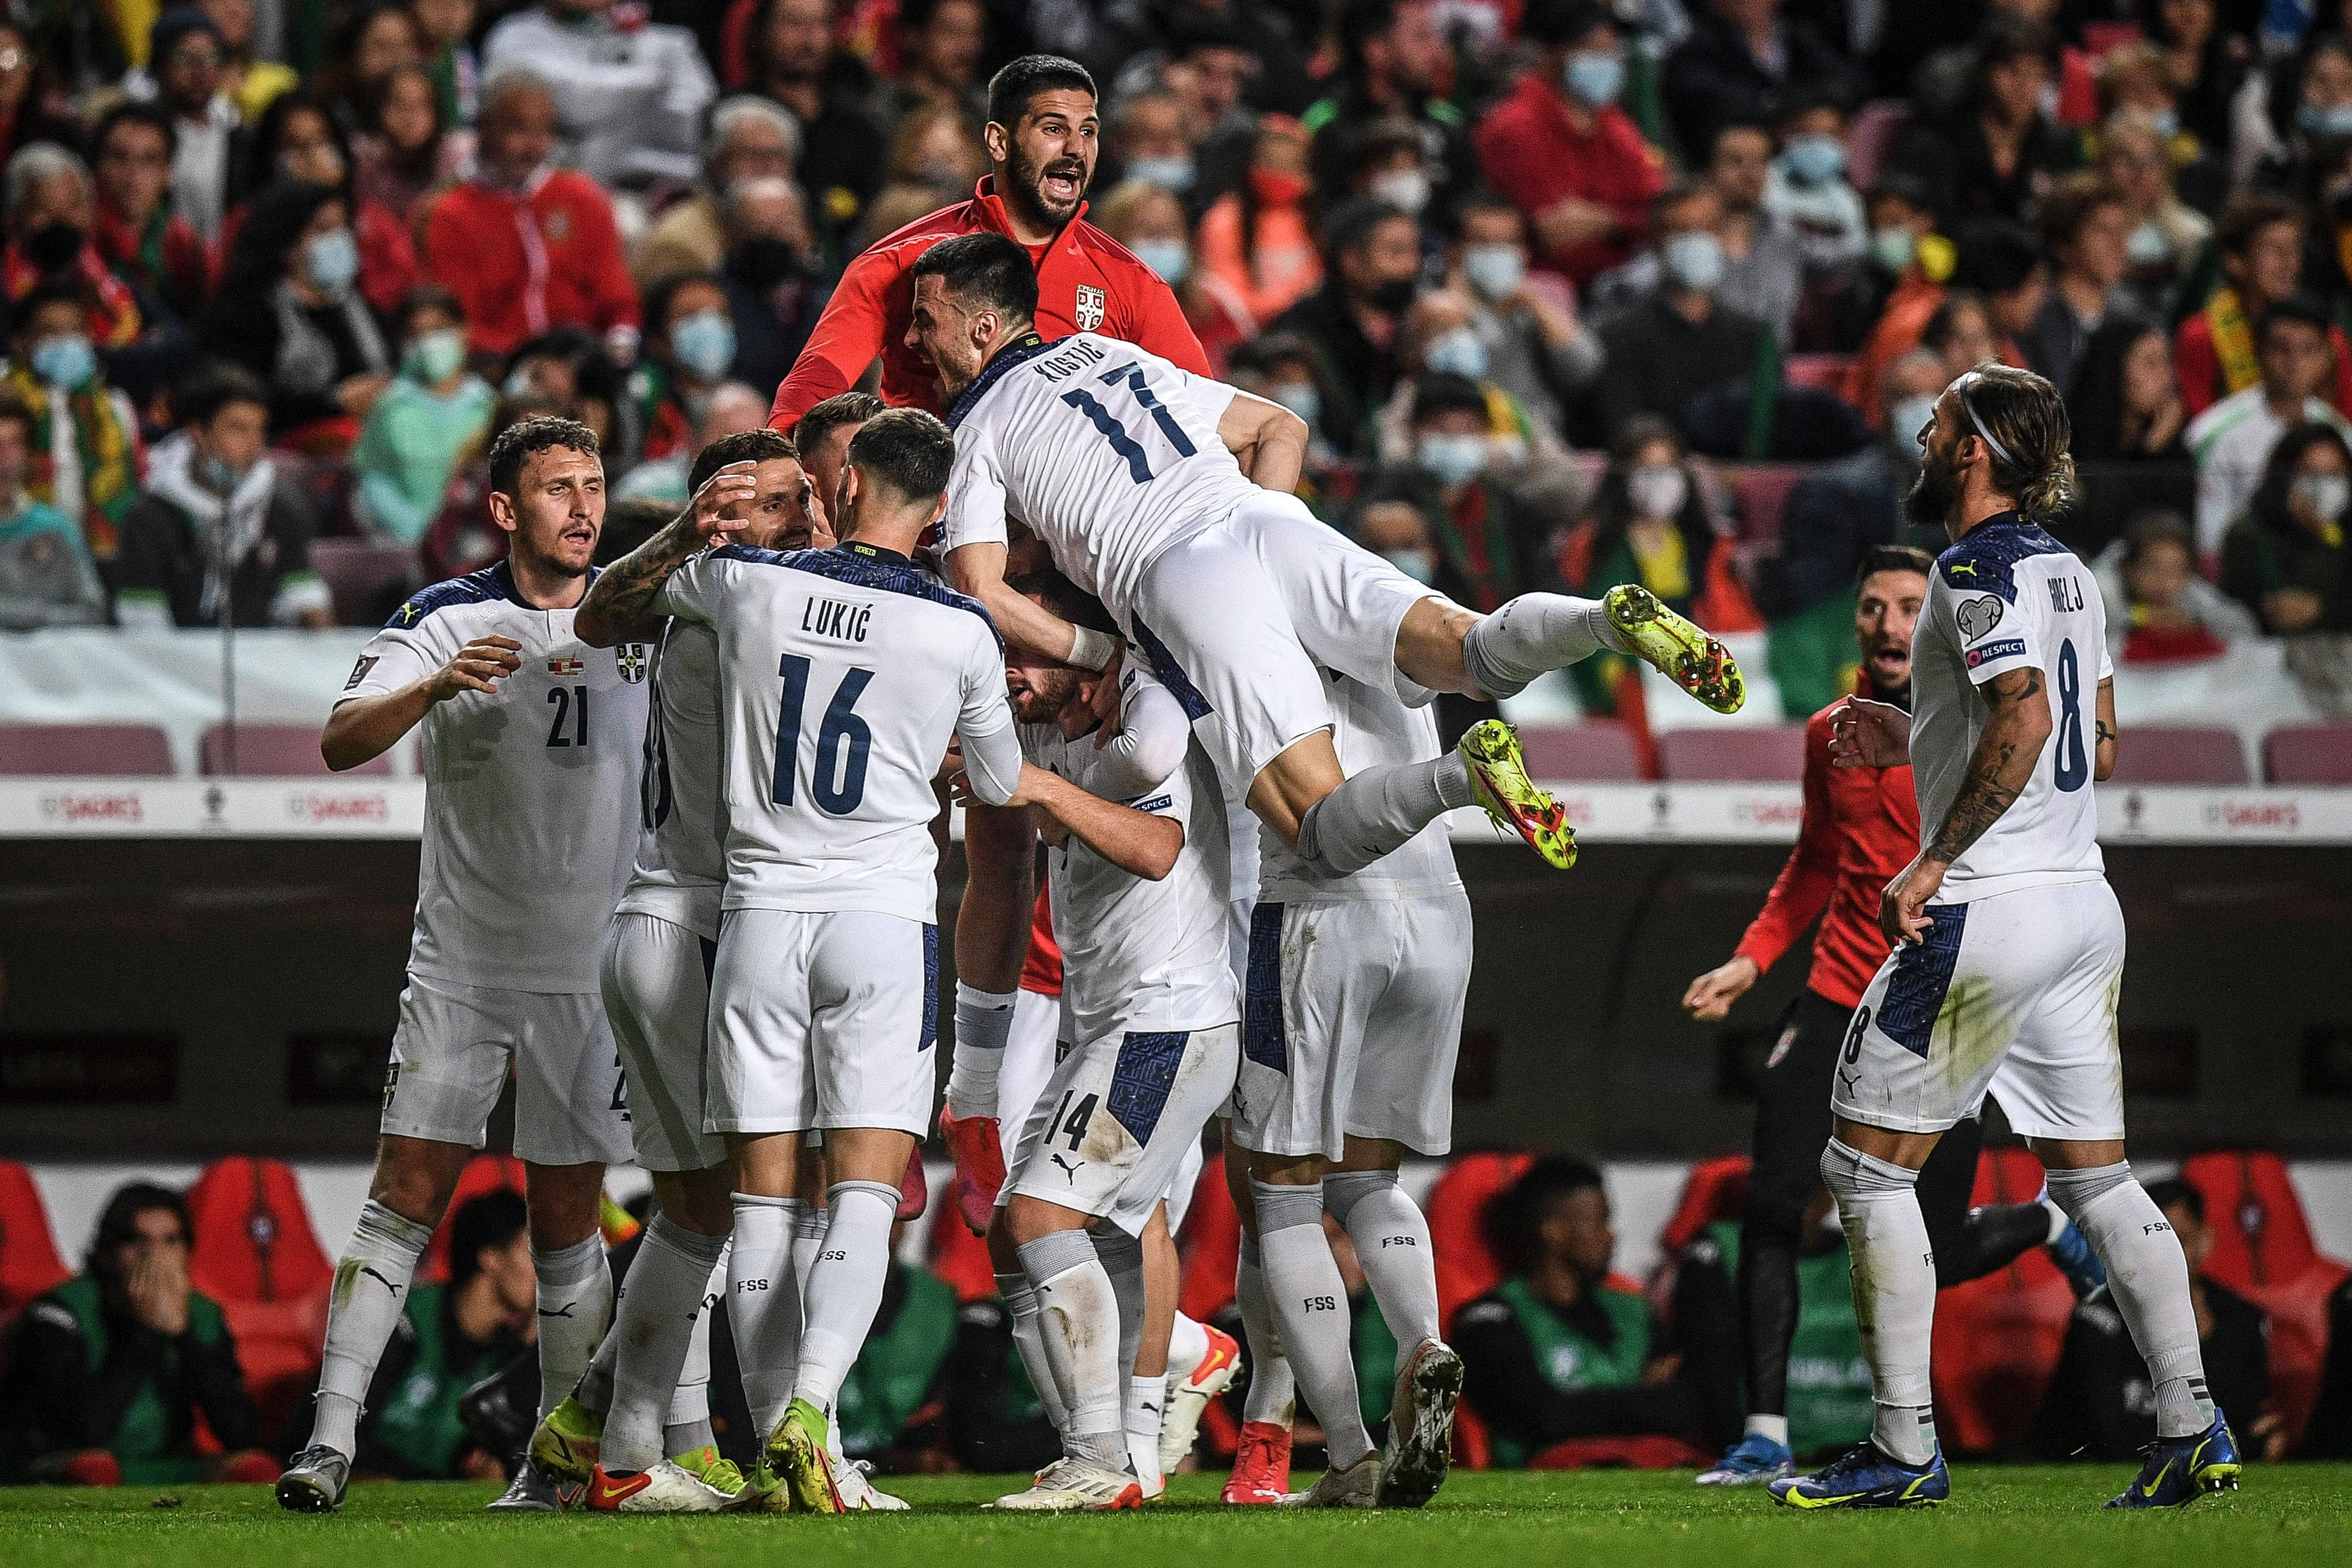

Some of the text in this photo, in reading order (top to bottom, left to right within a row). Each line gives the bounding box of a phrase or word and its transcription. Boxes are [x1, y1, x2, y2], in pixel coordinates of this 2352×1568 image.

[1033, 339, 1105, 383] KOSTIĆ
[1060, 361, 1198, 484] 17
[801, 596, 874, 642] LUKIĆ
[1982, 642, 2024, 659] RESPECT
[546, 685, 588, 748] 21
[772, 652, 876, 816] 16
[2054, 637, 2089, 793] 8
[1844, 1005, 1872, 1065] 8
[1044, 1090, 1100, 1153] 14
[1381, 1236, 1416, 1248] FSS
[2142, 1222, 2171, 1236] FSS
[815, 1250, 846, 1264] FSS
[737, 1279, 768, 1293] FSS
[1303, 1296, 1336, 1313] FSS
